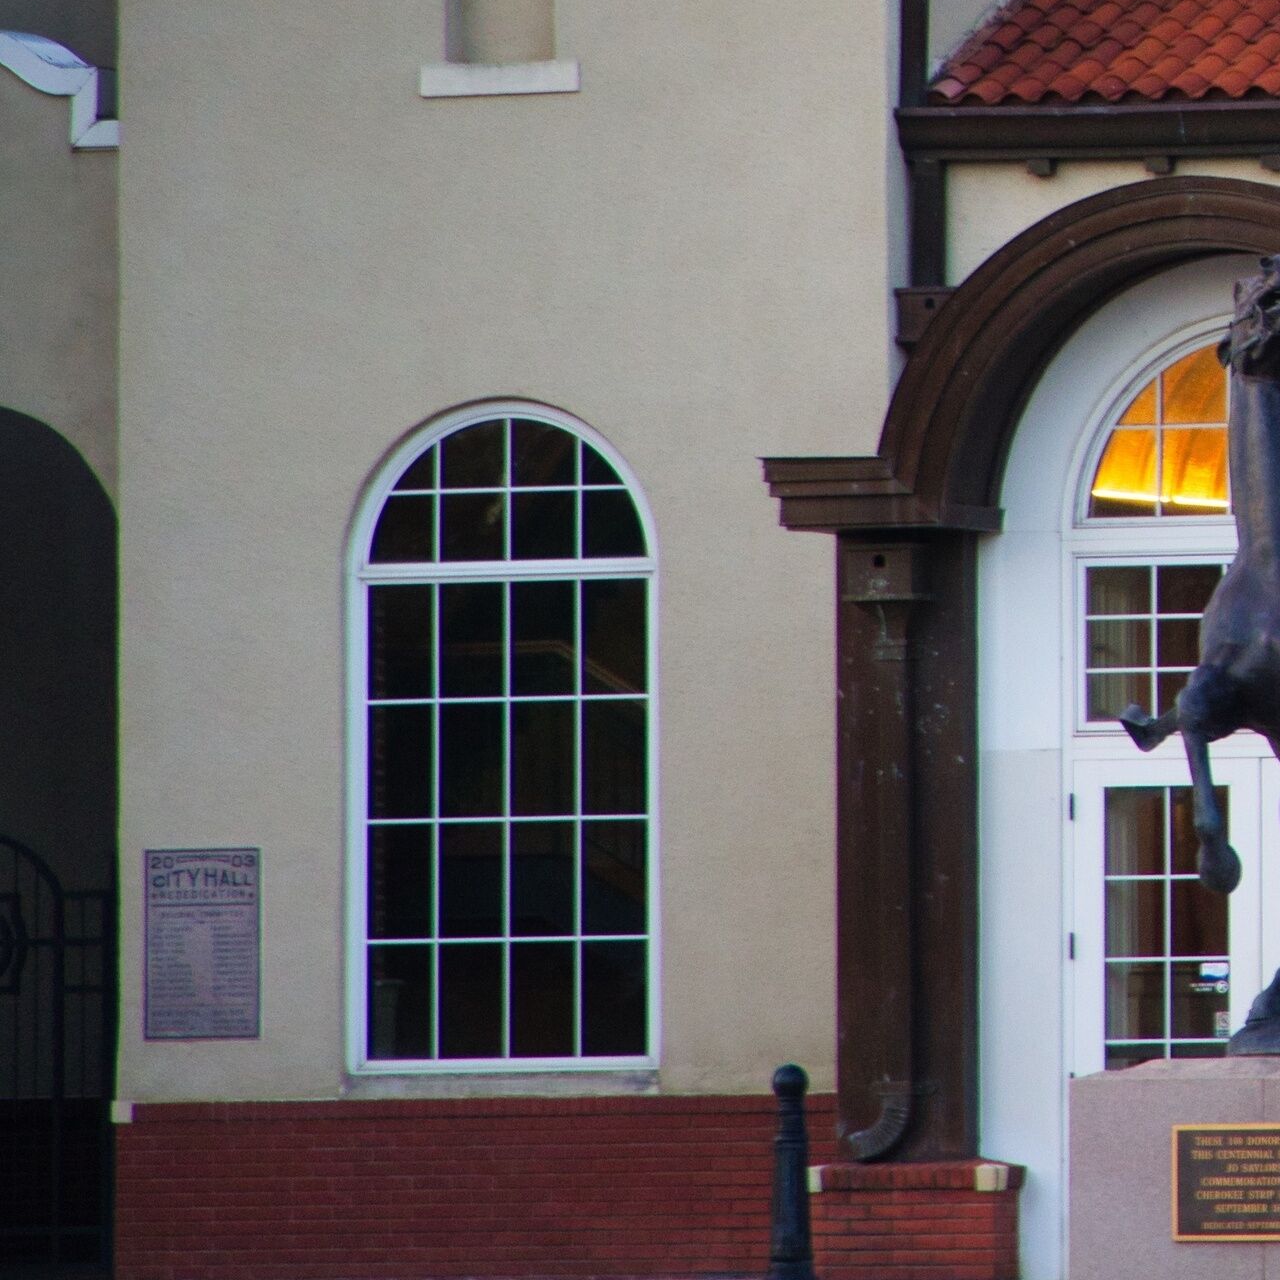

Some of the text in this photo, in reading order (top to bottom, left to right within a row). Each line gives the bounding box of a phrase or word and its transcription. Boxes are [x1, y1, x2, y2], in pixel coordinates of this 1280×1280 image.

[150, 855, 256, 870] 20 03
[152, 868, 253, 888] CITY HALL
[160, 889, 246, 900] REDEDICATION
[1192, 1150, 1213, 1160] THIS
[1217, 1150, 1274, 1159] CENTENNIAL
[1197, 1191, 1244, 1200] CHEROKEE
[1249, 1191, 1274, 1199] STRIP
[1215, 1204, 1268, 1213] SEPTEMBER
